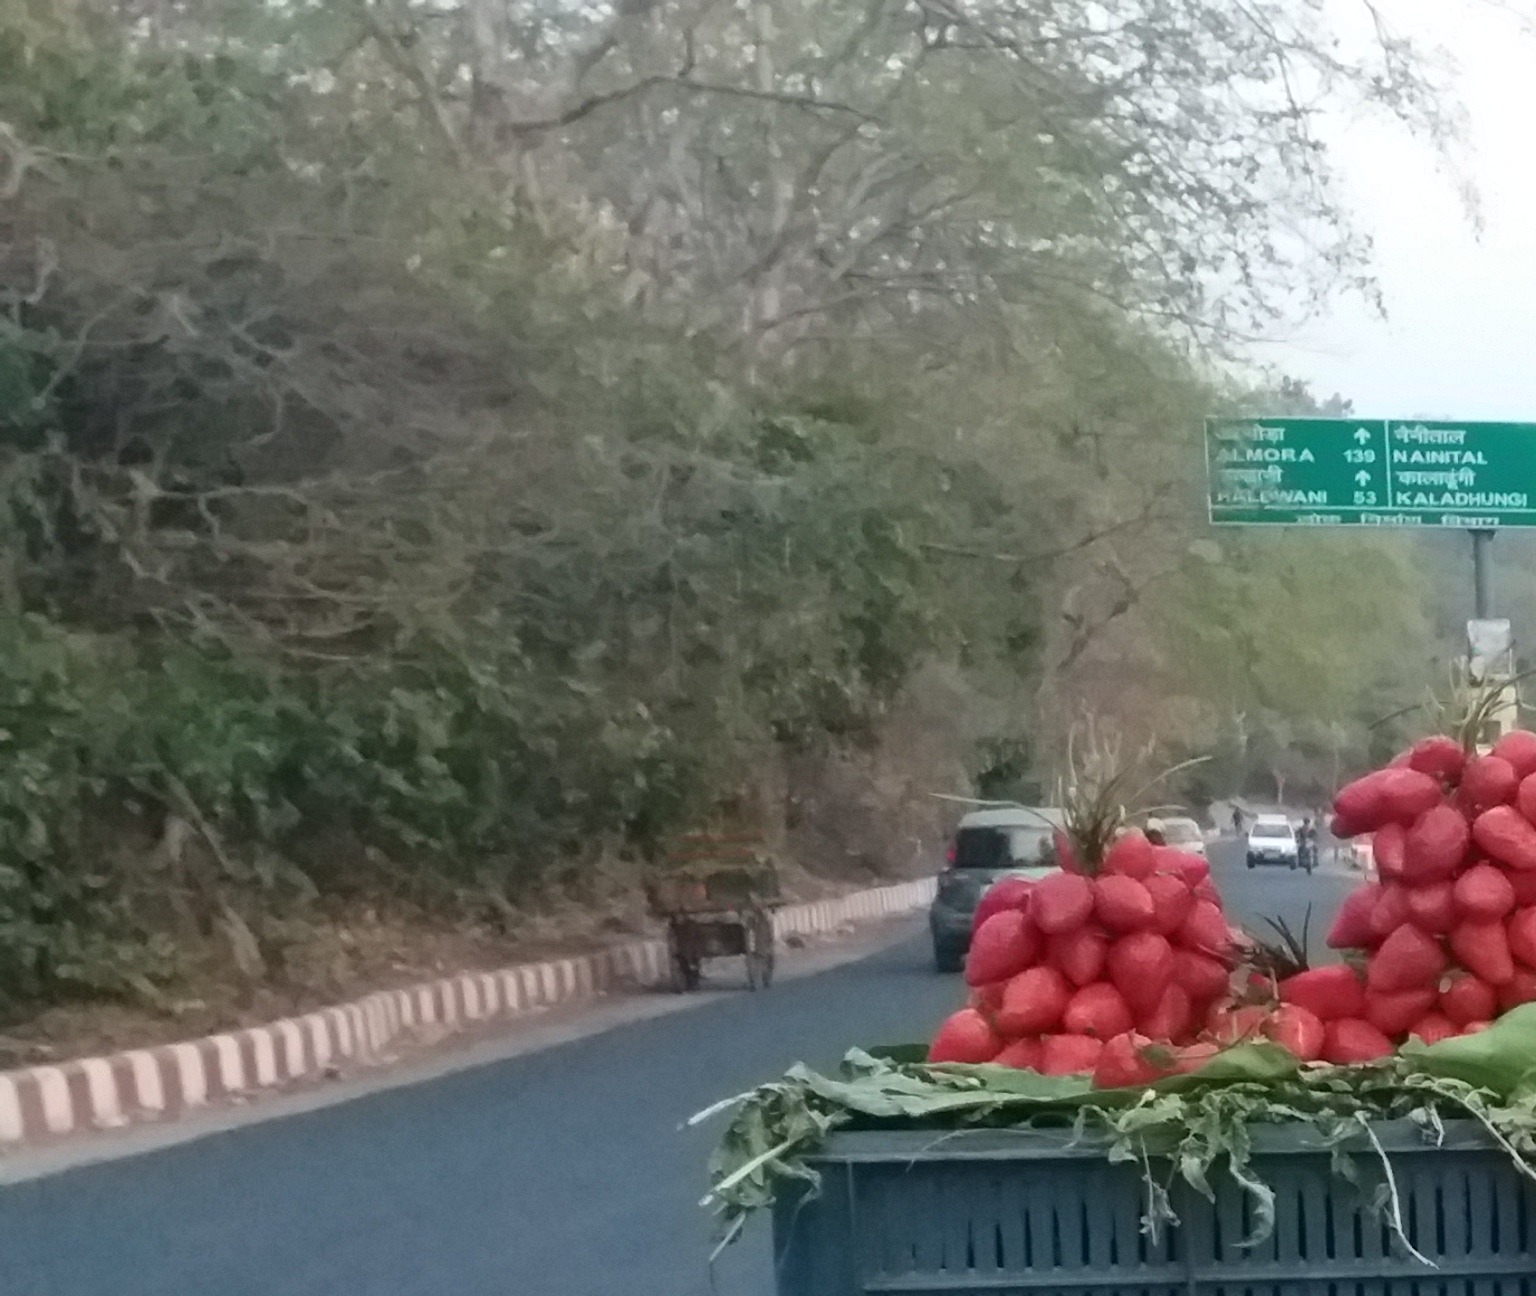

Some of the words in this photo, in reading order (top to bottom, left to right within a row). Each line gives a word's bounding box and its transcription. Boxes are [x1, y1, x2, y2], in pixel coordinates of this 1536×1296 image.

[1215, 448, 1315, 463] ALMORA
[1344, 449, 1376, 463] 139
[1393, 450, 1488, 465] NAINITAL
[1353, 491, 1377, 505] 53
[1396, 491, 1528, 507] KALADHUNGI
